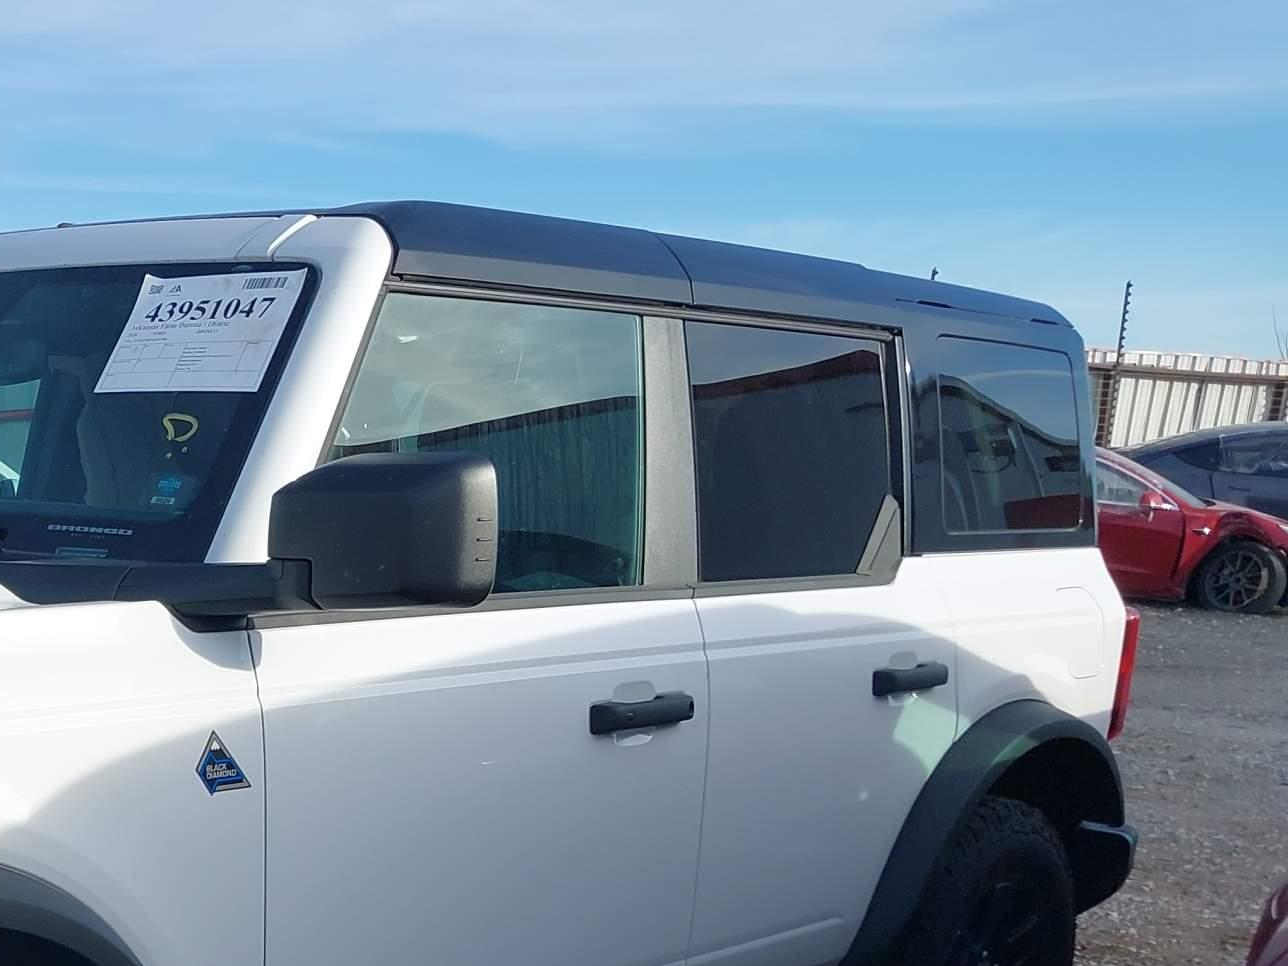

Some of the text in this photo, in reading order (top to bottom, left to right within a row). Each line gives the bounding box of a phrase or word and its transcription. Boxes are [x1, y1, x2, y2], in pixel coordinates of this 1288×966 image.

[145, 297, 277, 323] 43951047
[47, 524, 133, 536] BRONCO
[205, 763, 227, 773] BLACK
[206, 769, 237, 780] DIAMOND
